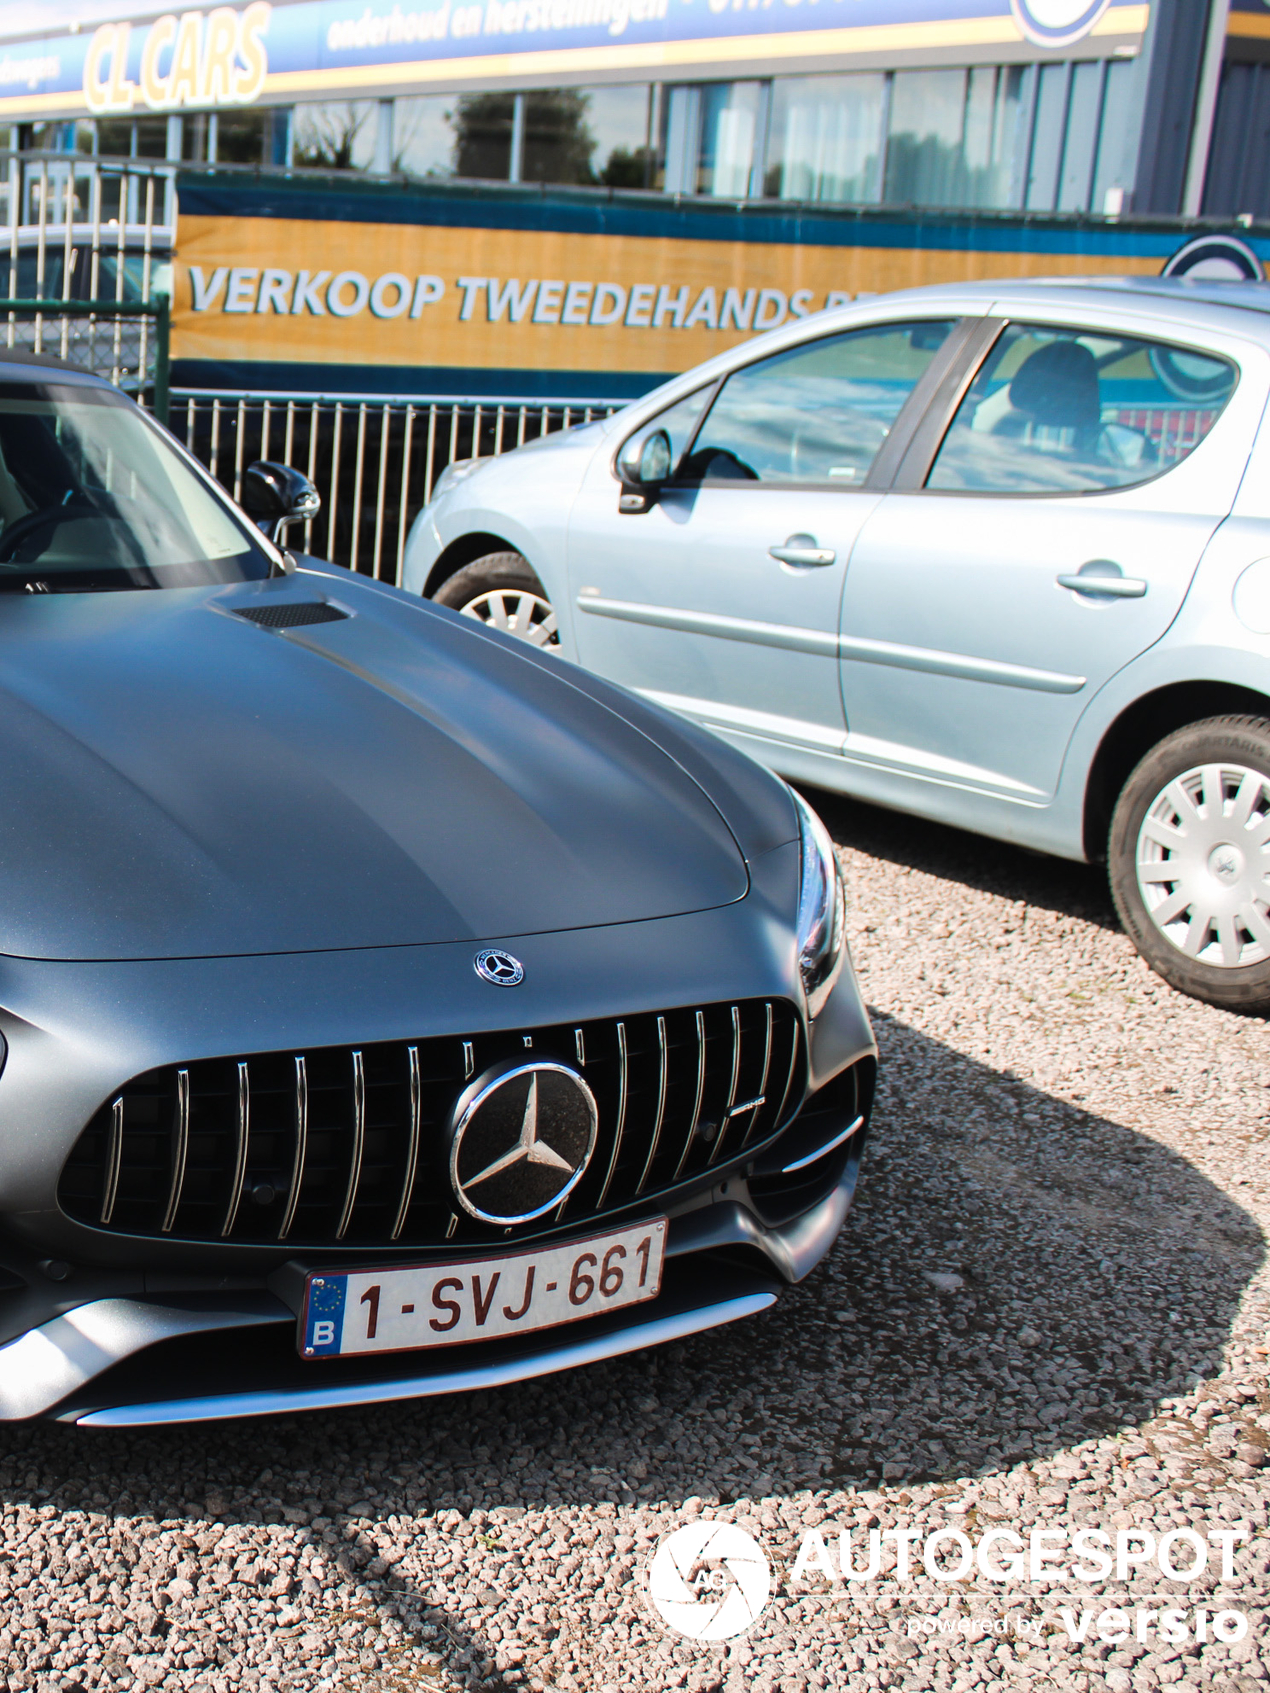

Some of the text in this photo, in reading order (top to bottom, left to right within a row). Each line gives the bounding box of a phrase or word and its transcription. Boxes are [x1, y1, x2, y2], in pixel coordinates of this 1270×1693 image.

[83, 22, 135, 114] CL
[140, 1, 273, 110] CARS
[189, 265, 815, 332] VERKOOP TWEEDEHANDS
[359, 1235, 653, 1340] 1-SVJ-661
[312, 1320, 335, 1347] B
